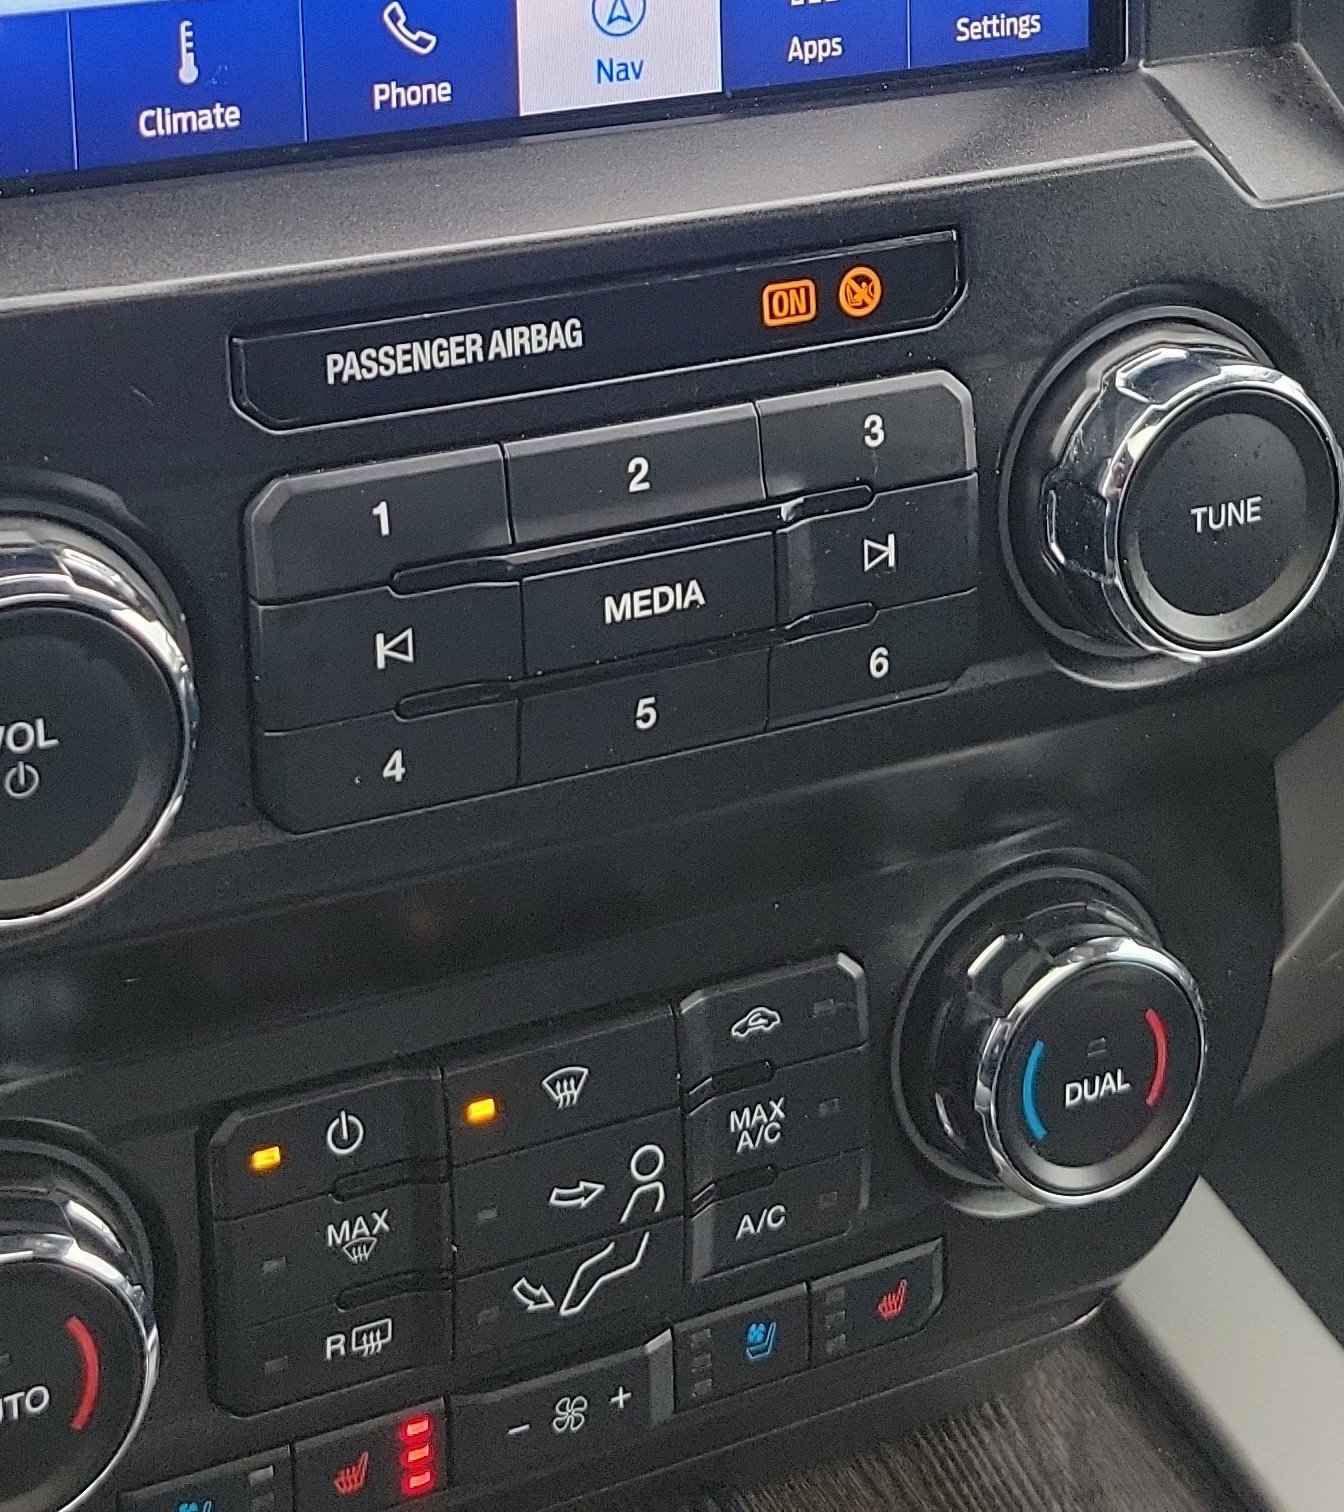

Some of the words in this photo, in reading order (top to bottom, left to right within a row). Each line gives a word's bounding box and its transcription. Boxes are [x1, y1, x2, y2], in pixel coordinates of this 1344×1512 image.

[955, 13, 1041, 42] Settings
[787, 36, 843, 65] Apps
[596, 59, 645, 84] Nav
[373, 79, 452, 111] Phone
[139, 103, 241, 137] Climate
[770, 289, 808, 317] ON
[325, 325, 484, 385] PASSENGER
[487, 318, 584, 360] AIRBAG
[864, 414, 885, 447] 3
[627, 457, 651, 493] 2
[372, 500, 390, 537] 1
[1190, 496, 1263, 534] TUNE
[604, 580, 706, 624] MEDIA
[868, 647, 890, 678] 6
[635, 697, 657, 730] 5
[382, 750, 407, 782] 4
[1064, 1068, 1131, 1108] DUAL
[729, 1096, 786, 1134] MAX
[736, 1121, 783, 1153] A/C
[327, 1209, 391, 1248] MAX
[736, 1205, 787, 1238] A/C
[325, 1333, 346, 1358] R
